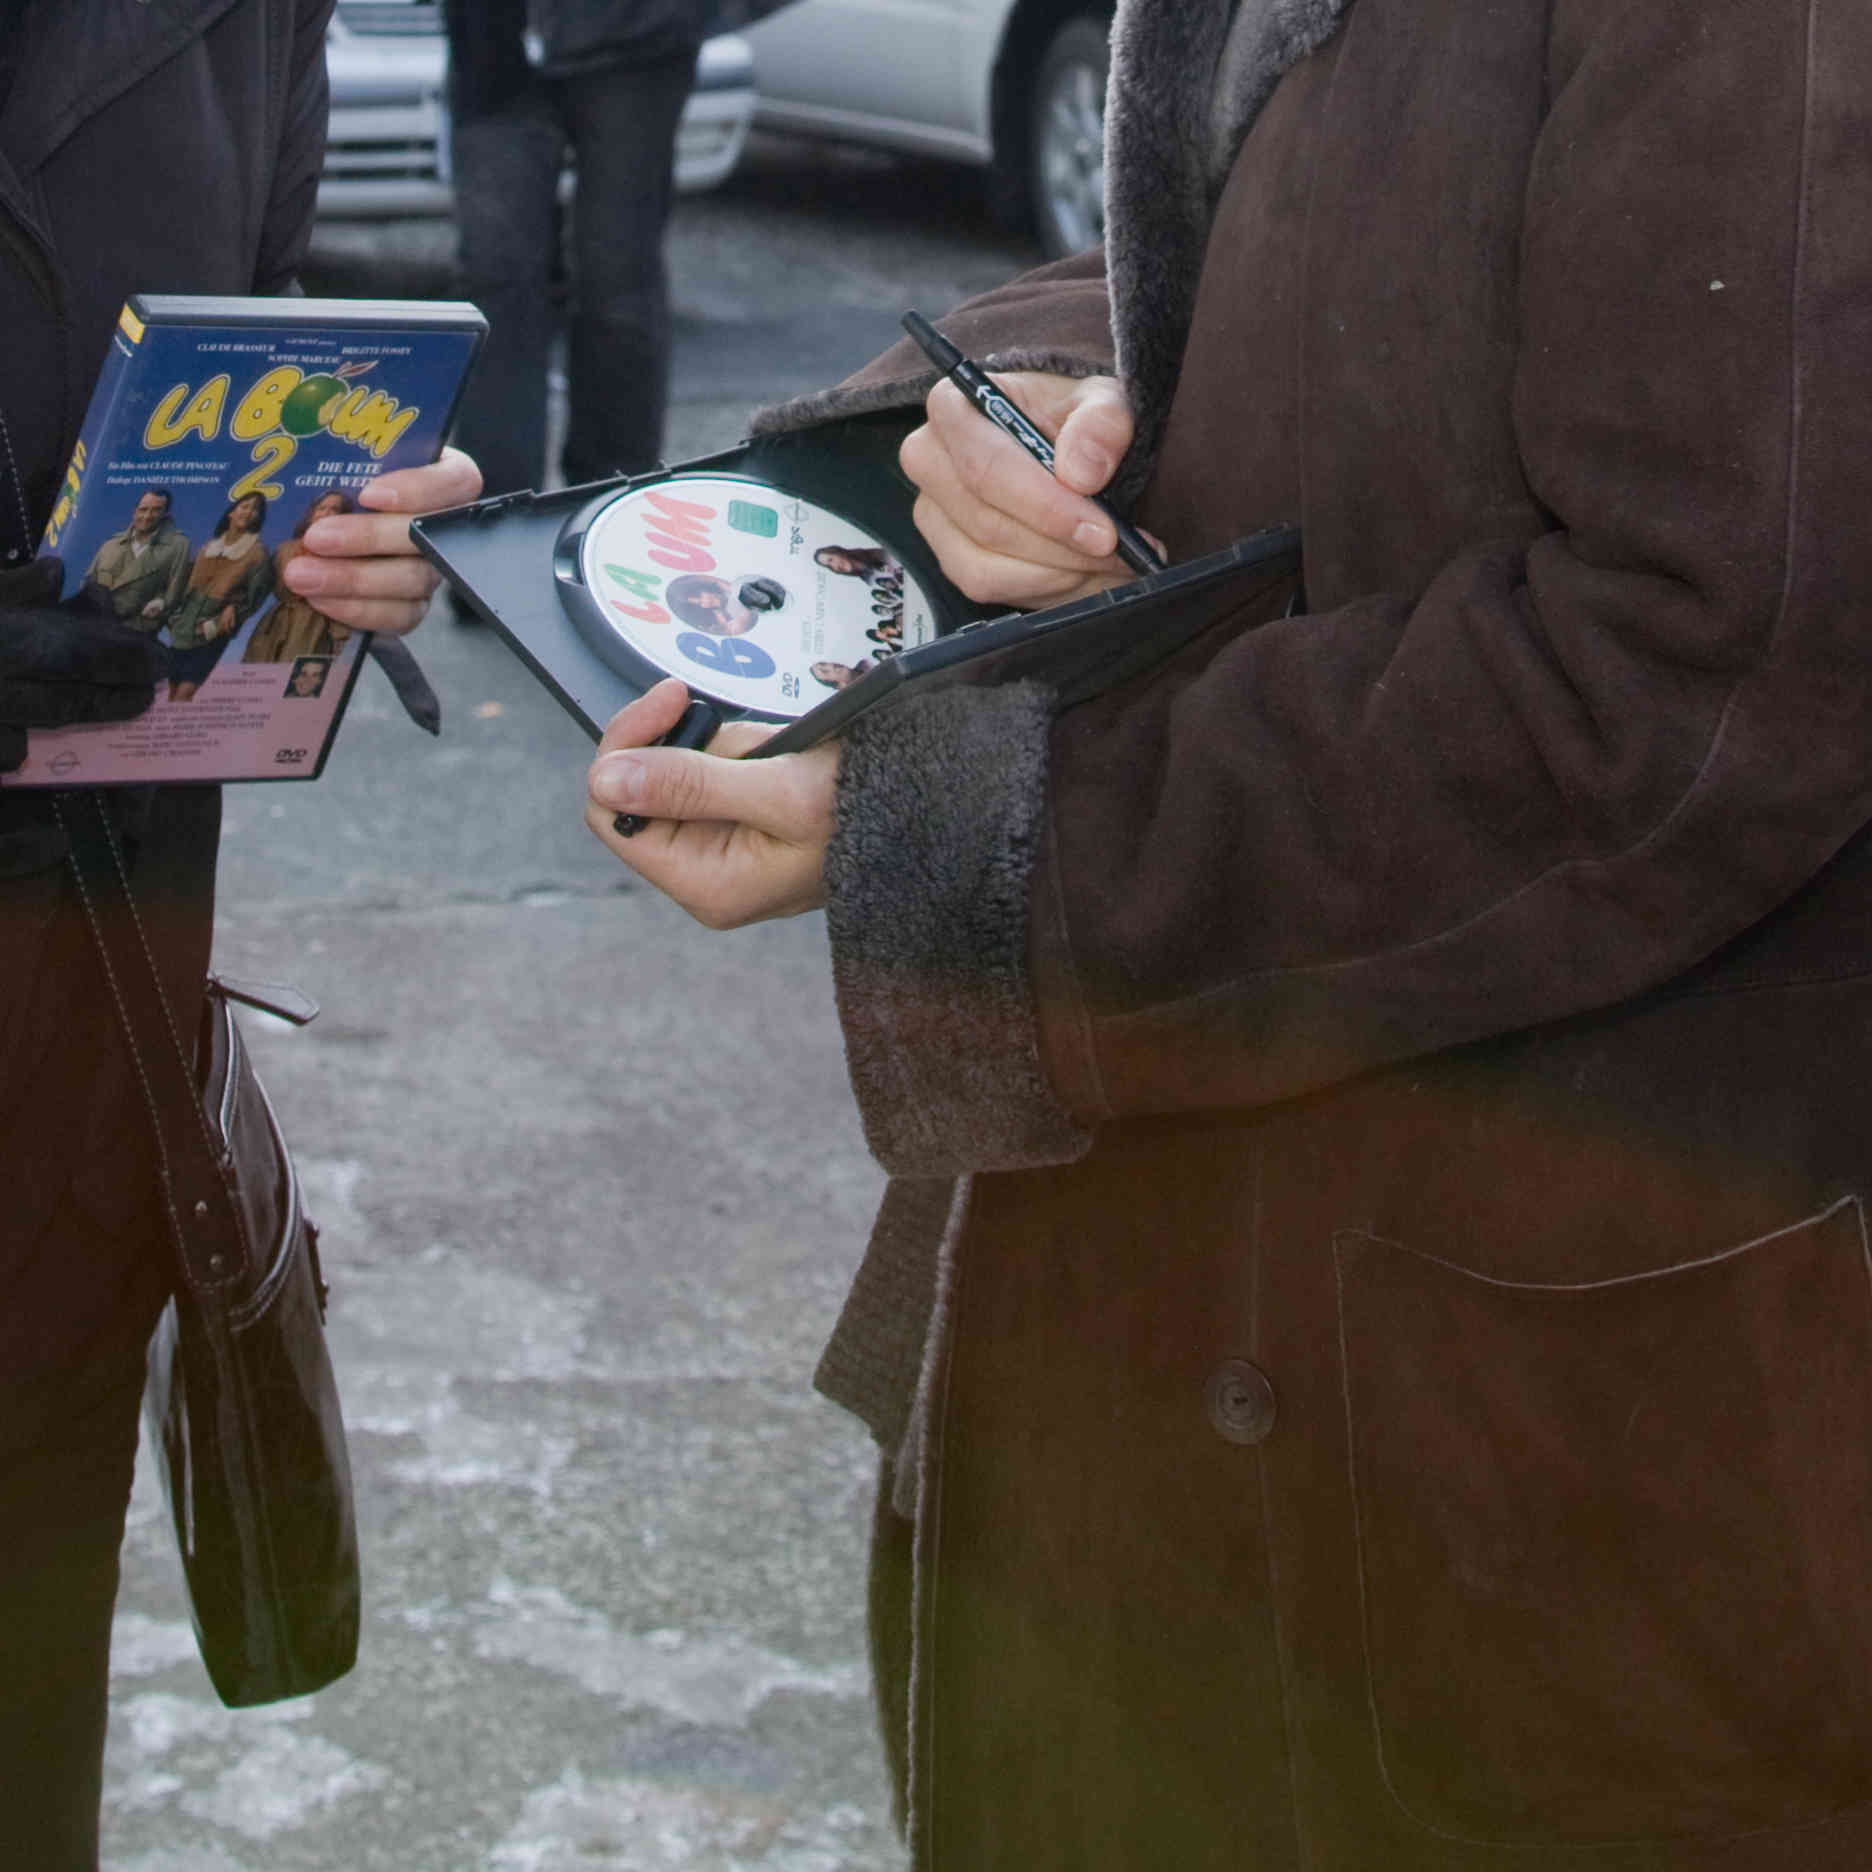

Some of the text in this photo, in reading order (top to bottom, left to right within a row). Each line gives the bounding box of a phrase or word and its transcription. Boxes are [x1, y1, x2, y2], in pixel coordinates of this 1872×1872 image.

[144, 374, 231, 450] LA
[228, 432, 299, 502] 2
[295, 474, 337, 488] GEHT
[317, 461, 344, 474] DIE
[603, 562, 671, 625] LA
[275, 748, 308, 759] DVD
